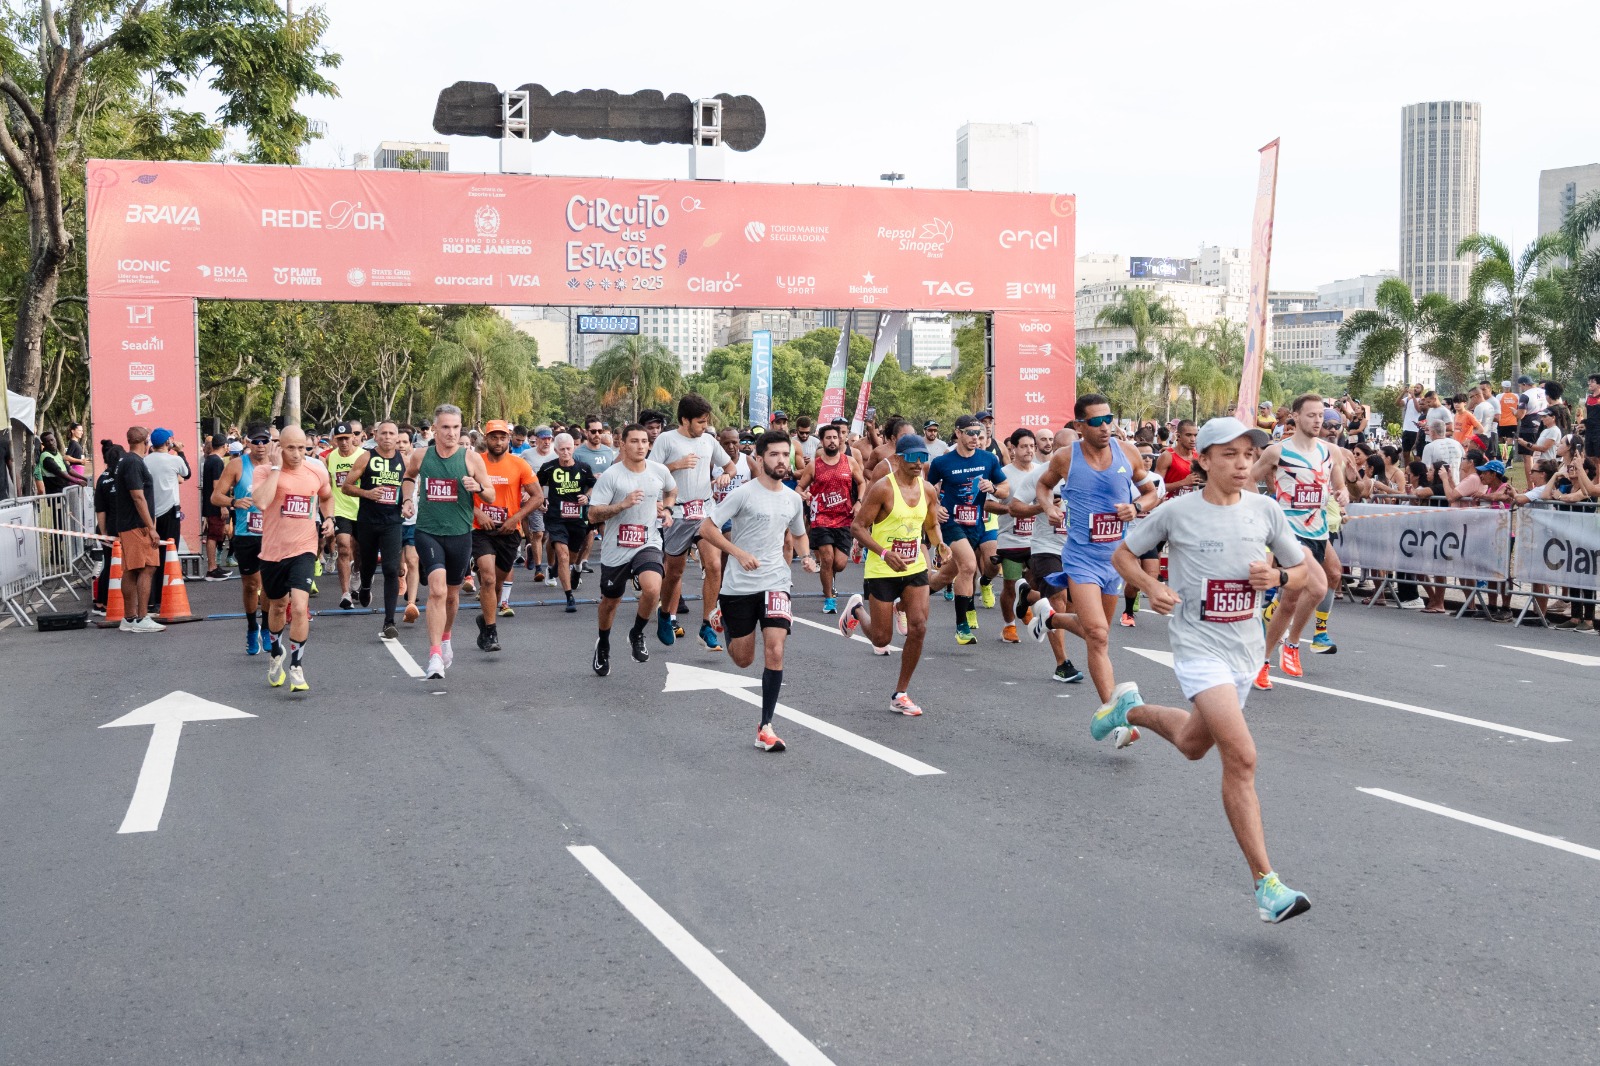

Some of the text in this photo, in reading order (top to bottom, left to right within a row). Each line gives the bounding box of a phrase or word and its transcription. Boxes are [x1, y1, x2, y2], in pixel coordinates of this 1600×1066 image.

[125, 204, 200, 225] BRAVA
[261, 208, 322, 229] REDE
[621, 227, 646, 243] das
[770, 225, 830, 234] TOKIO MARINE
[877, 226, 916, 241] Repsol
[770, 233, 826, 242] SEGURADORA
[999, 225, 1058, 249] enel
[442, 243, 532, 255] RIO DE JANEIRO
[899, 238, 944, 254] Sinopec
[214, 266, 248, 277] BMA
[290, 268, 318, 277] PLANT
[290, 277, 322, 286] POWER
[434, 274, 493, 286] ourocard
[507, 274, 541, 287] VISA
[632, 275, 664, 291] 2025
[687, 277, 733, 293] Claro
[776, 275, 816, 289] LUPO
[787, 287, 816, 295] SPORT
[849, 285, 889, 294] Heineken
[922, 280, 974, 297] TAG
[1023, 283, 1056, 295] CYMI
[1019, 323, 1052, 333] YoPRO
[121, 339, 164, 351] Seadrill
[1019, 367, 1051, 375] RUNNING
[1019, 373, 1040, 381] LAND
[430, 484, 451, 496] 17648
[287, 500, 308, 513] 17029
[252, 518, 262, 529] 163
[1096, 518, 1122, 535] 17379
[622, 531, 643, 542] 17322
[1399, 523, 1468, 562] enel
[1543, 537, 1600, 576] Clar
[1213, 592, 1252, 612] 15566
